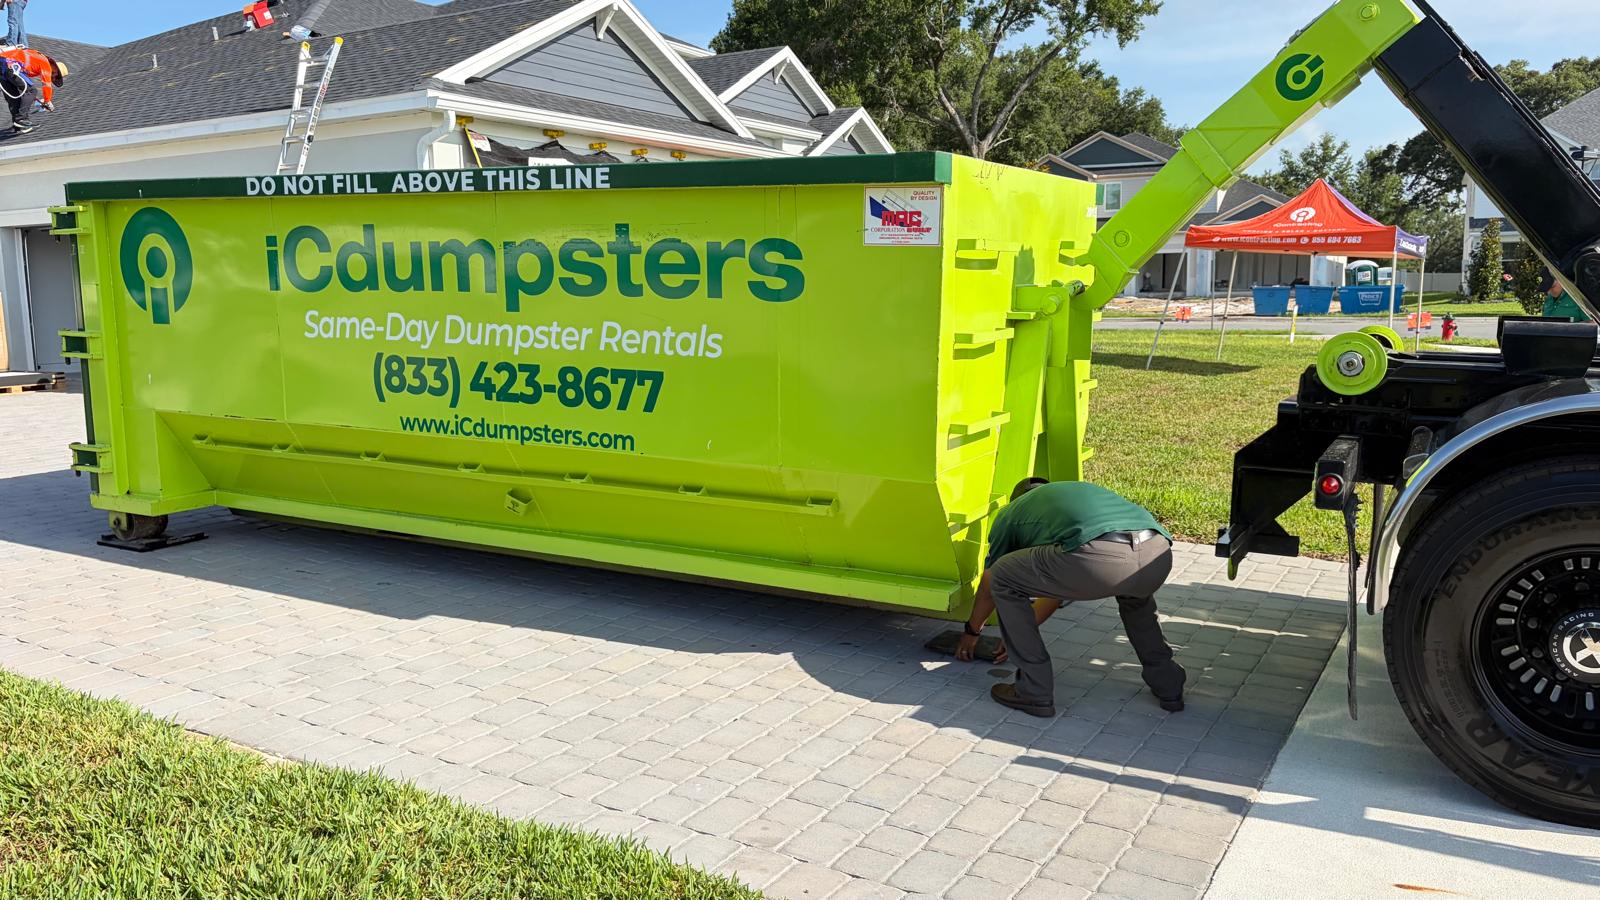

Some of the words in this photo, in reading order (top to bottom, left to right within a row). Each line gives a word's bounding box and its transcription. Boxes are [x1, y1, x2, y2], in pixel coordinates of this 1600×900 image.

[246, 176, 276, 196] DO
[283, 175, 326, 195] NOT
[332, 174, 378, 194] FILL
[391, 171, 475, 193] ABOVE
[482, 169, 541, 191] THIS
[550, 167, 611, 189] LINE
[265, 223, 805, 313] iCdumpsters
[303, 310, 439, 350] Same-Day
[444, 314, 593, 356] Dumpster
[599, 320, 723, 359] Rentals
[373, 352, 461, 408] (833)
[469, 361, 664, 413] 423-8677
[400, 414, 635, 451] www.iCdumpsters.com
[1441, 504, 1600, 599] ENDURANC
[1558, 612, 1595, 631] RACING
[1552, 633, 1579, 677] AMERICAN
